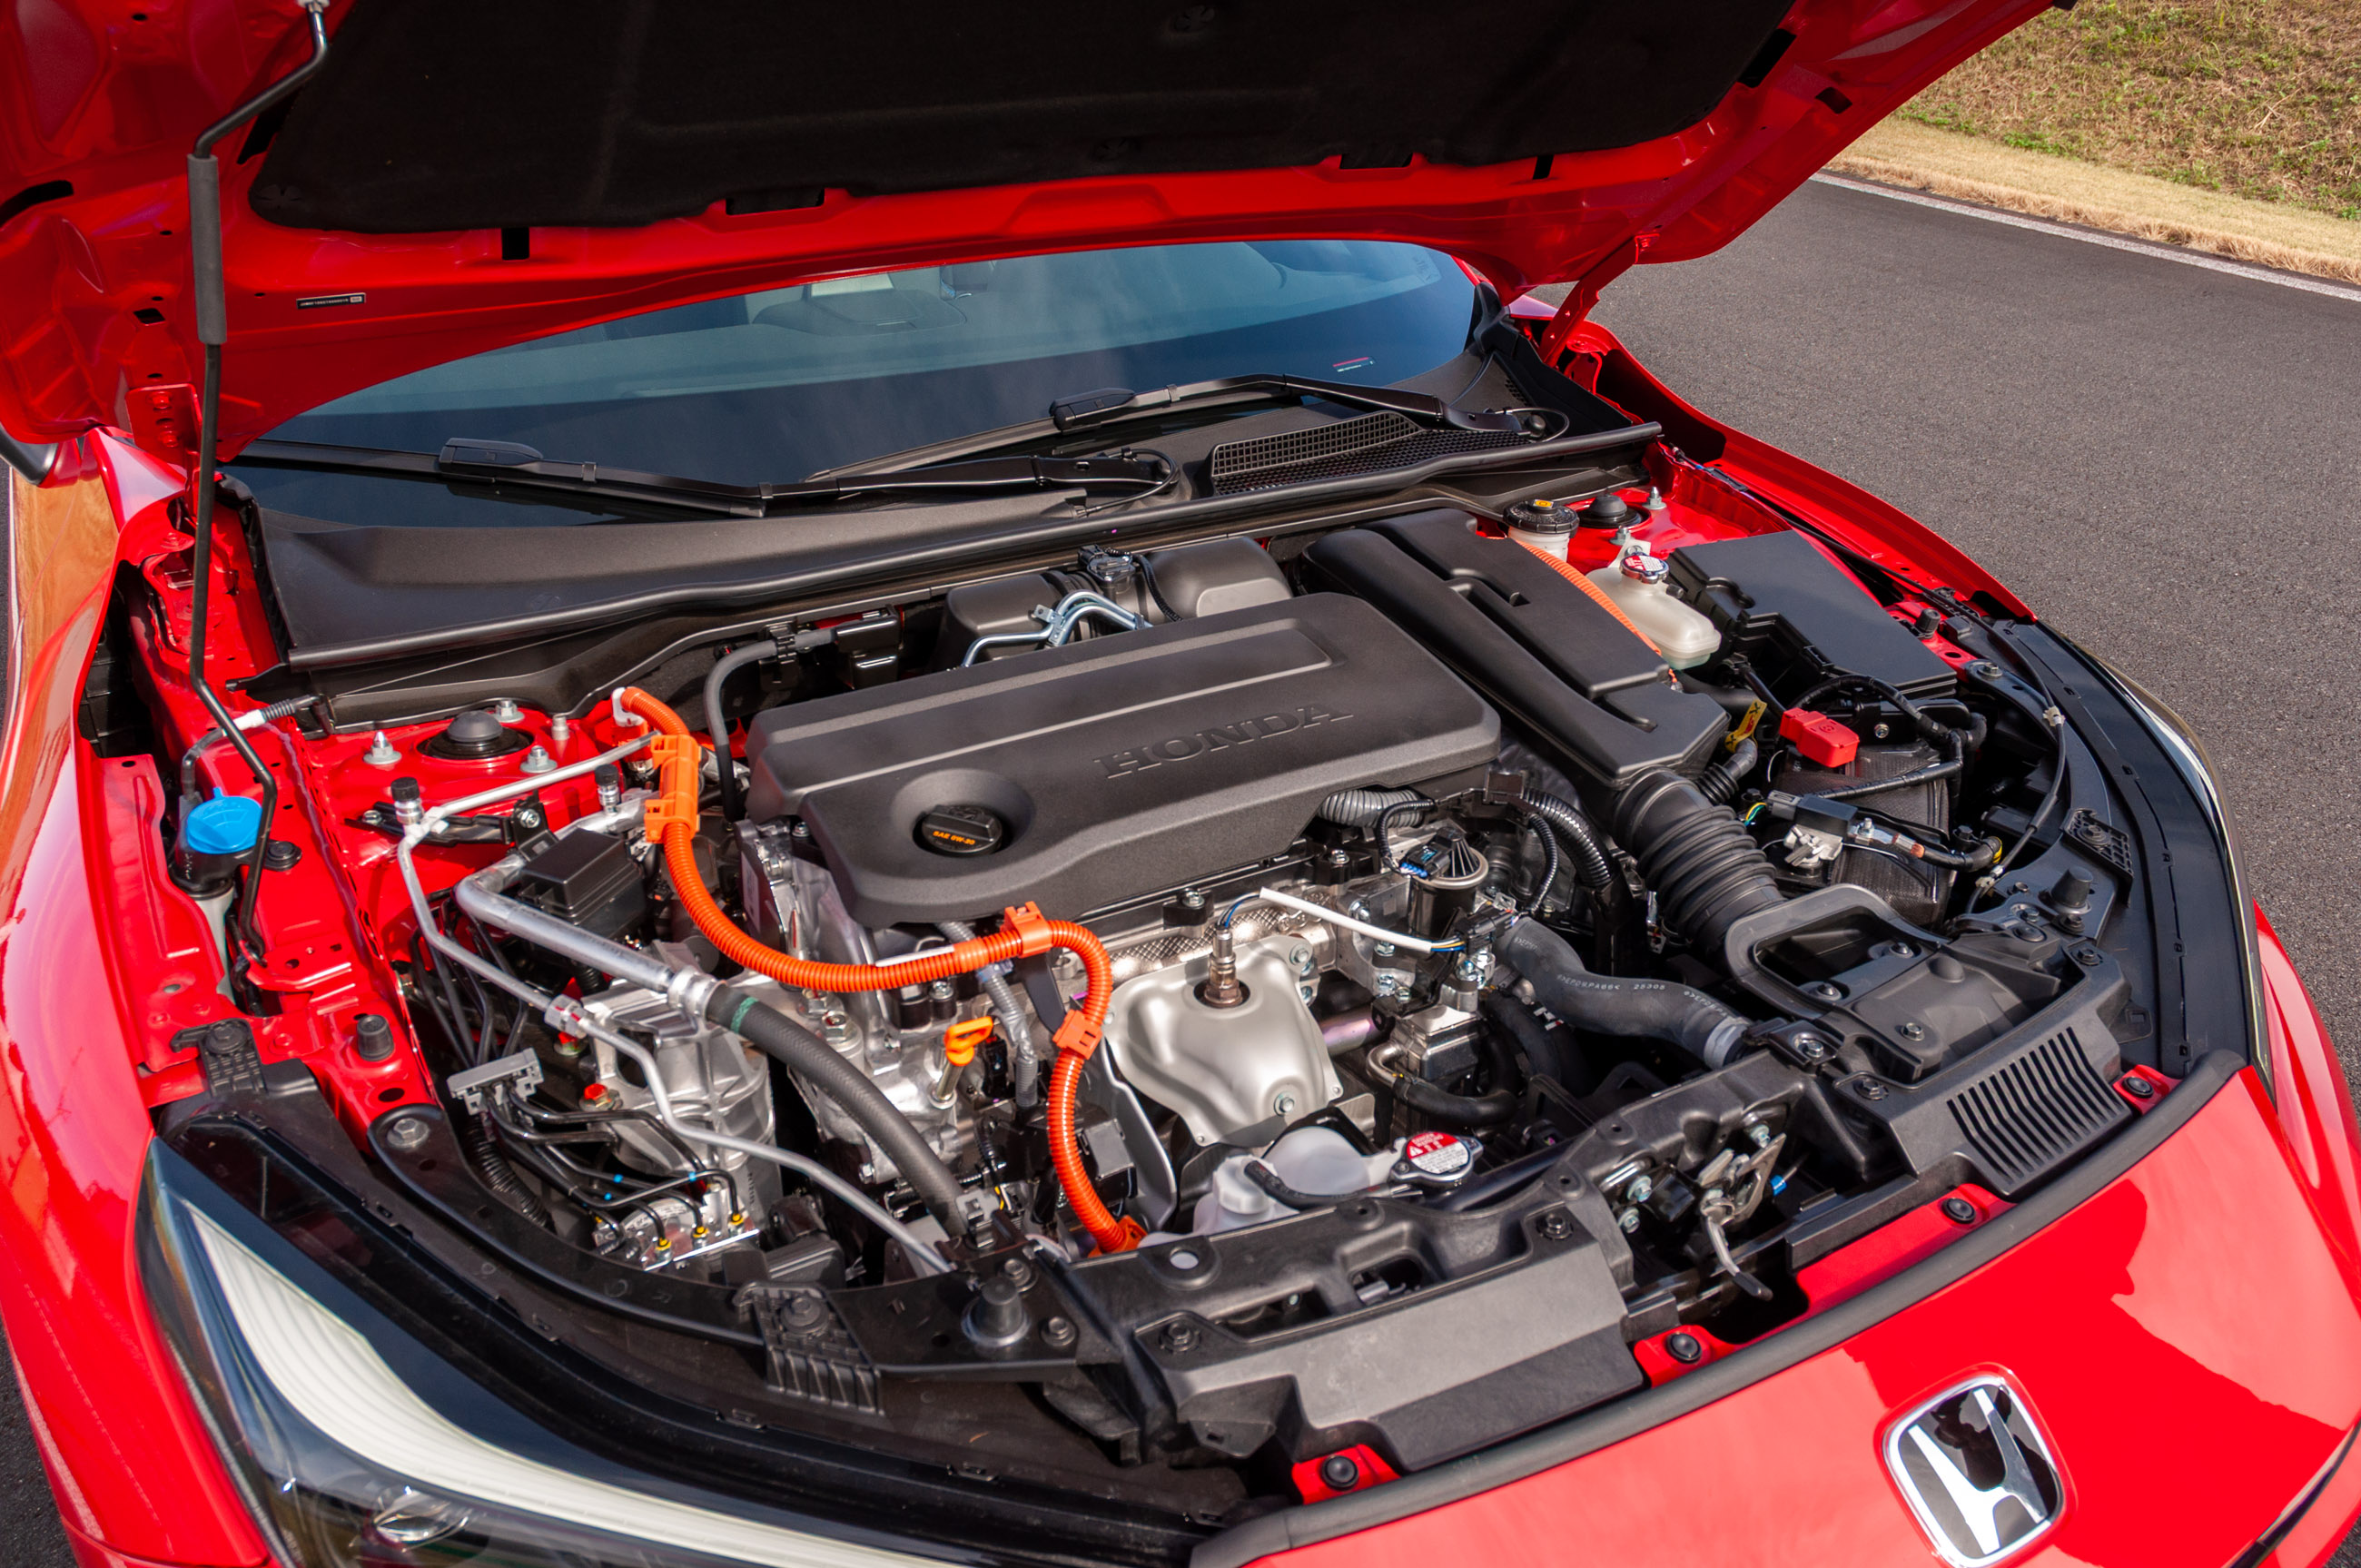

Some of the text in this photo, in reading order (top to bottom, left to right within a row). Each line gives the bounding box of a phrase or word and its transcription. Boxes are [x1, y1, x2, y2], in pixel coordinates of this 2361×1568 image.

[1093, 703, 1353, 779] HONDA
[933, 831, 975, 845] SAE 0W-20
